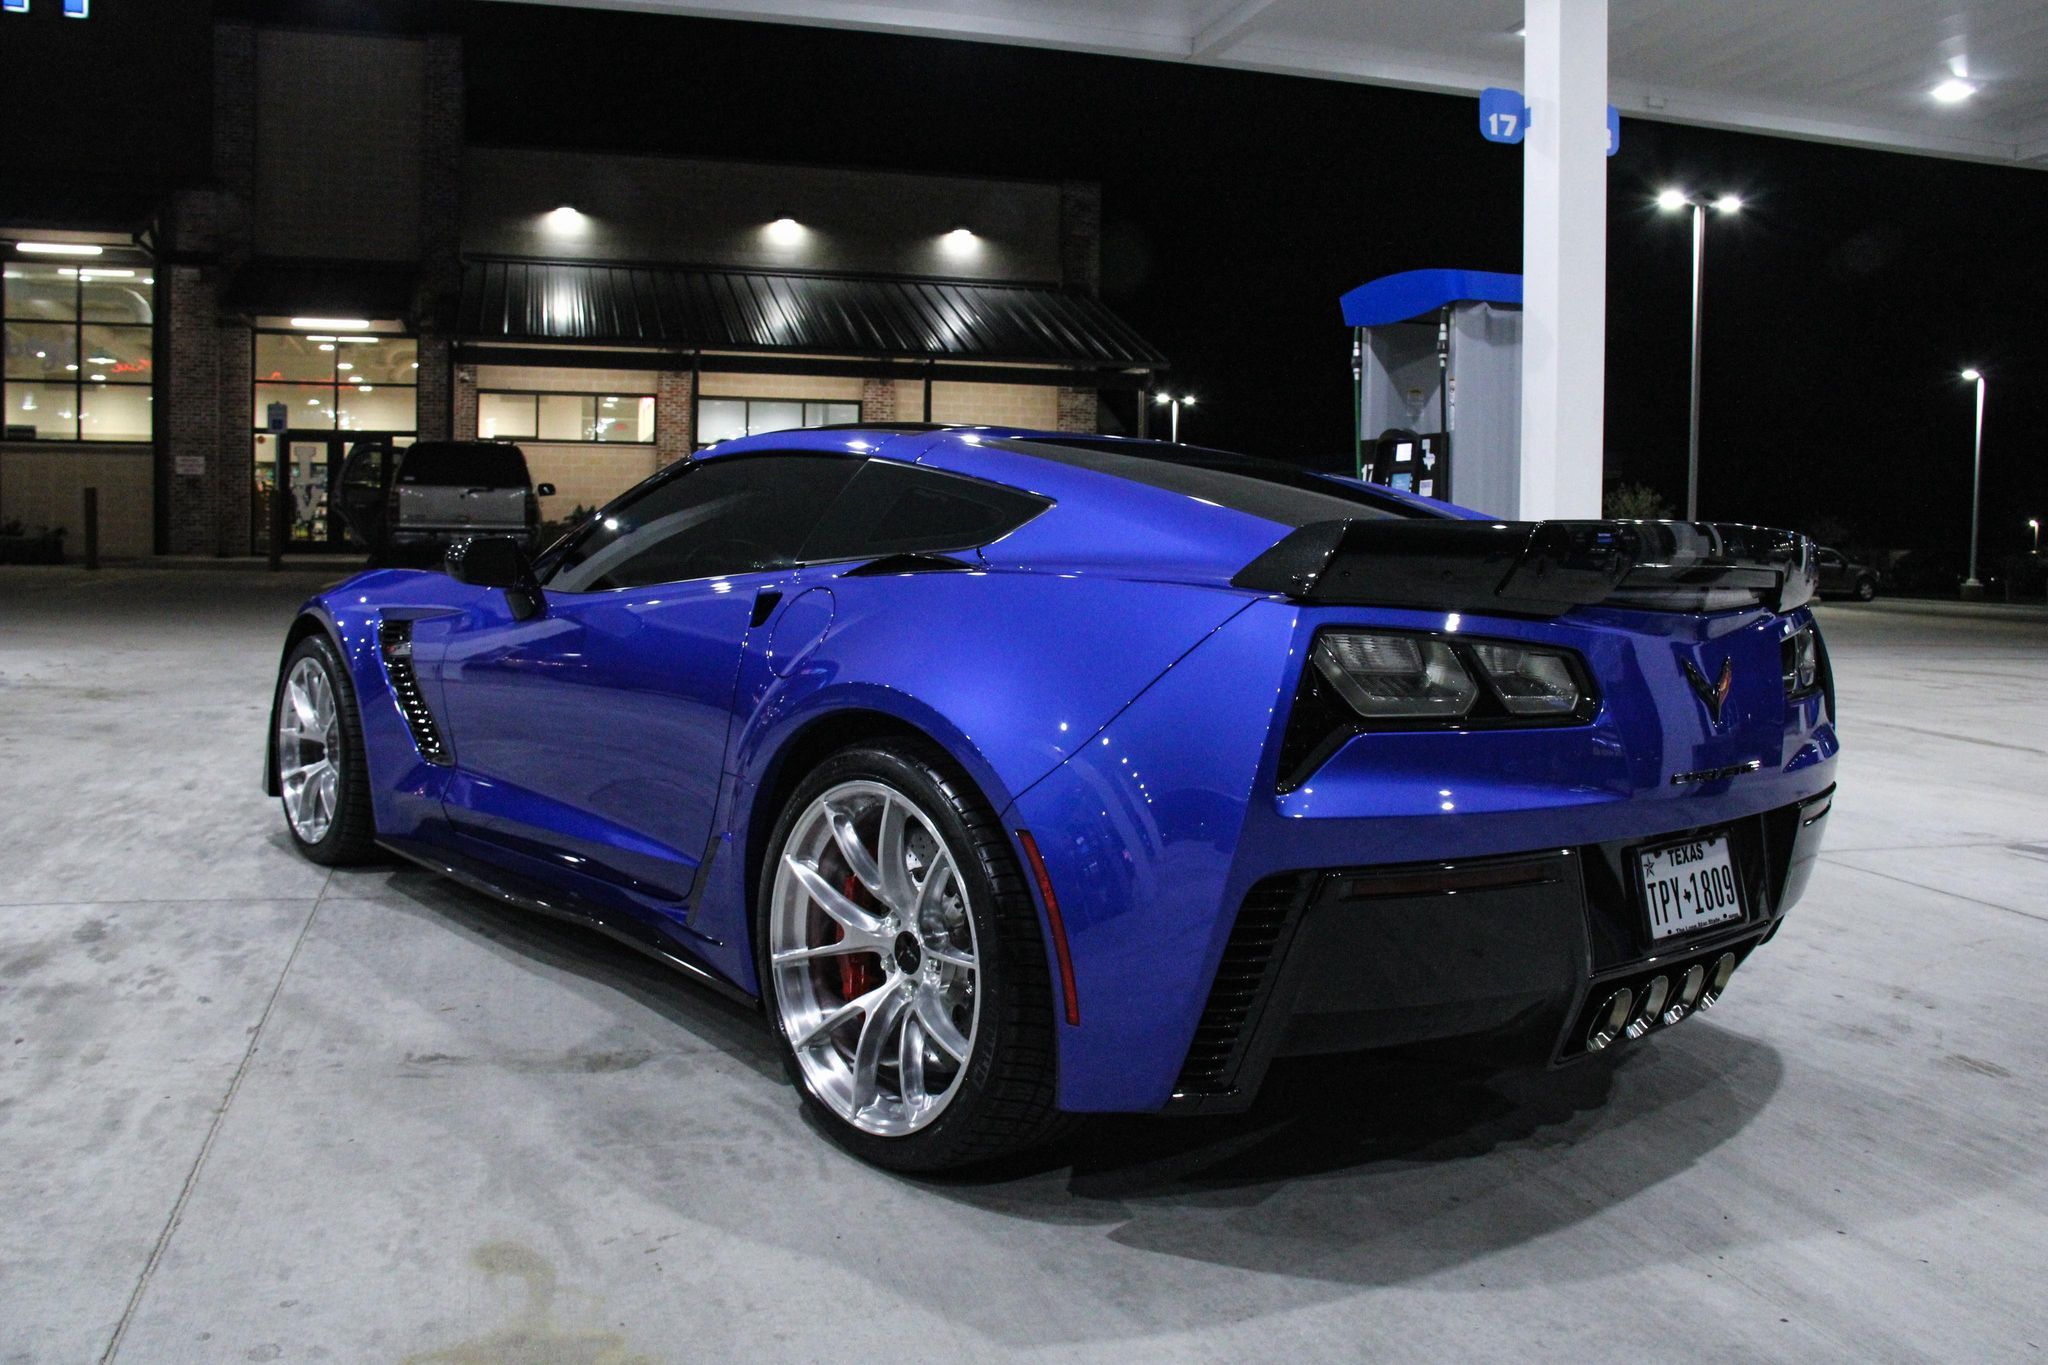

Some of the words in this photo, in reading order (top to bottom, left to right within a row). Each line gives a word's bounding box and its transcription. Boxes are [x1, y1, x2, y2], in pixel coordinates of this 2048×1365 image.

[1488, 113, 1518, 137] 17
[1361, 464, 1374, 483] 17
[1667, 843, 1704, 867] TEXAS
[1647, 876, 1683, 926] TPY
[1690, 865, 1735, 914] 1809
